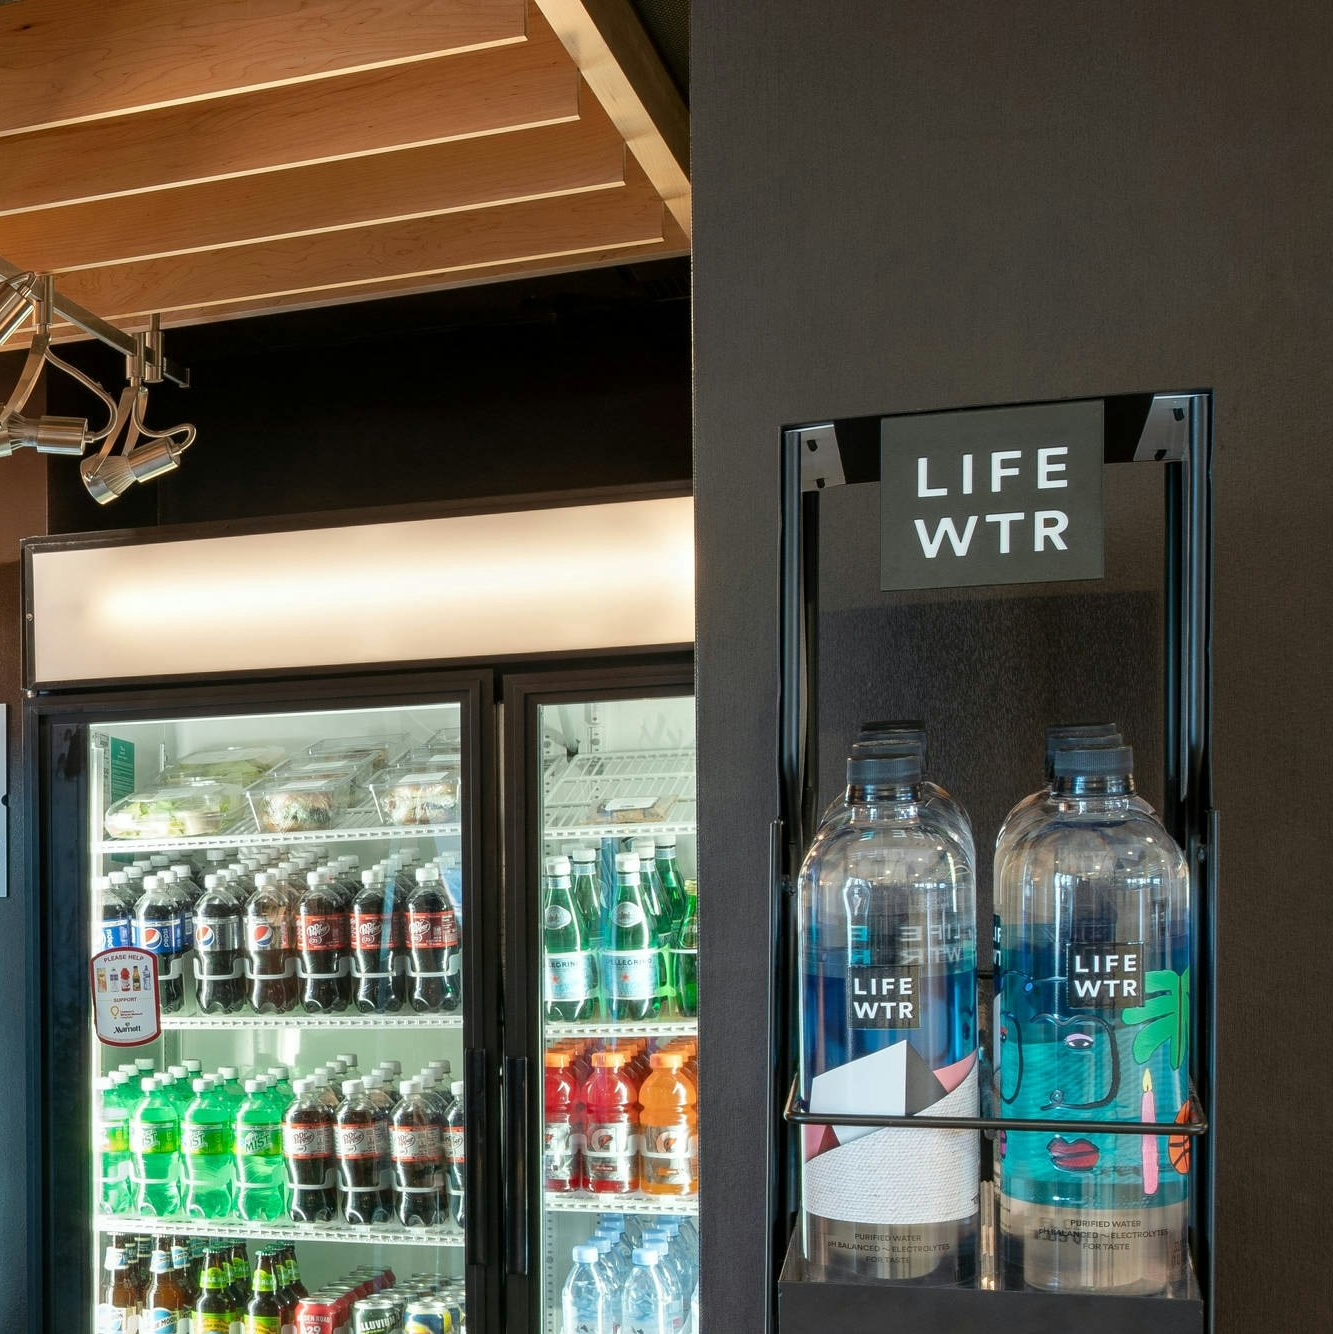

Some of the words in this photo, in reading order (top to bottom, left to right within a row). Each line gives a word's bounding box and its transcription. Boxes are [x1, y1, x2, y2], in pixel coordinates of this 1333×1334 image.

[917, 446, 1068, 498] LIFE
[914, 510, 1069, 559] WTR
[104, 955, 127, 963] PLEASE
[1074, 954, 1137, 973] LIFE
[854, 978, 913, 996] LIFE
[1073, 980, 1138, 998] WTR
[853, 1002, 913, 1019] WTR
[1070, 1219, 1110, 1228] PURIFIED
[1112, 1220, 1141, 1228] WATER
[855, 1233, 891, 1242] PURIFIED
[893, 1234, 922, 1242] WATER
[1050, 1229, 1098, 1239] BALANCED
[1110, 1228, 1168, 1239] ELECTROLYTES
[837, 1242, 880, 1251] BALANCED
[892, 1243, 950, 1252] ELECTROLYTES
[1083, 1242, 1101, 1250] FOR
